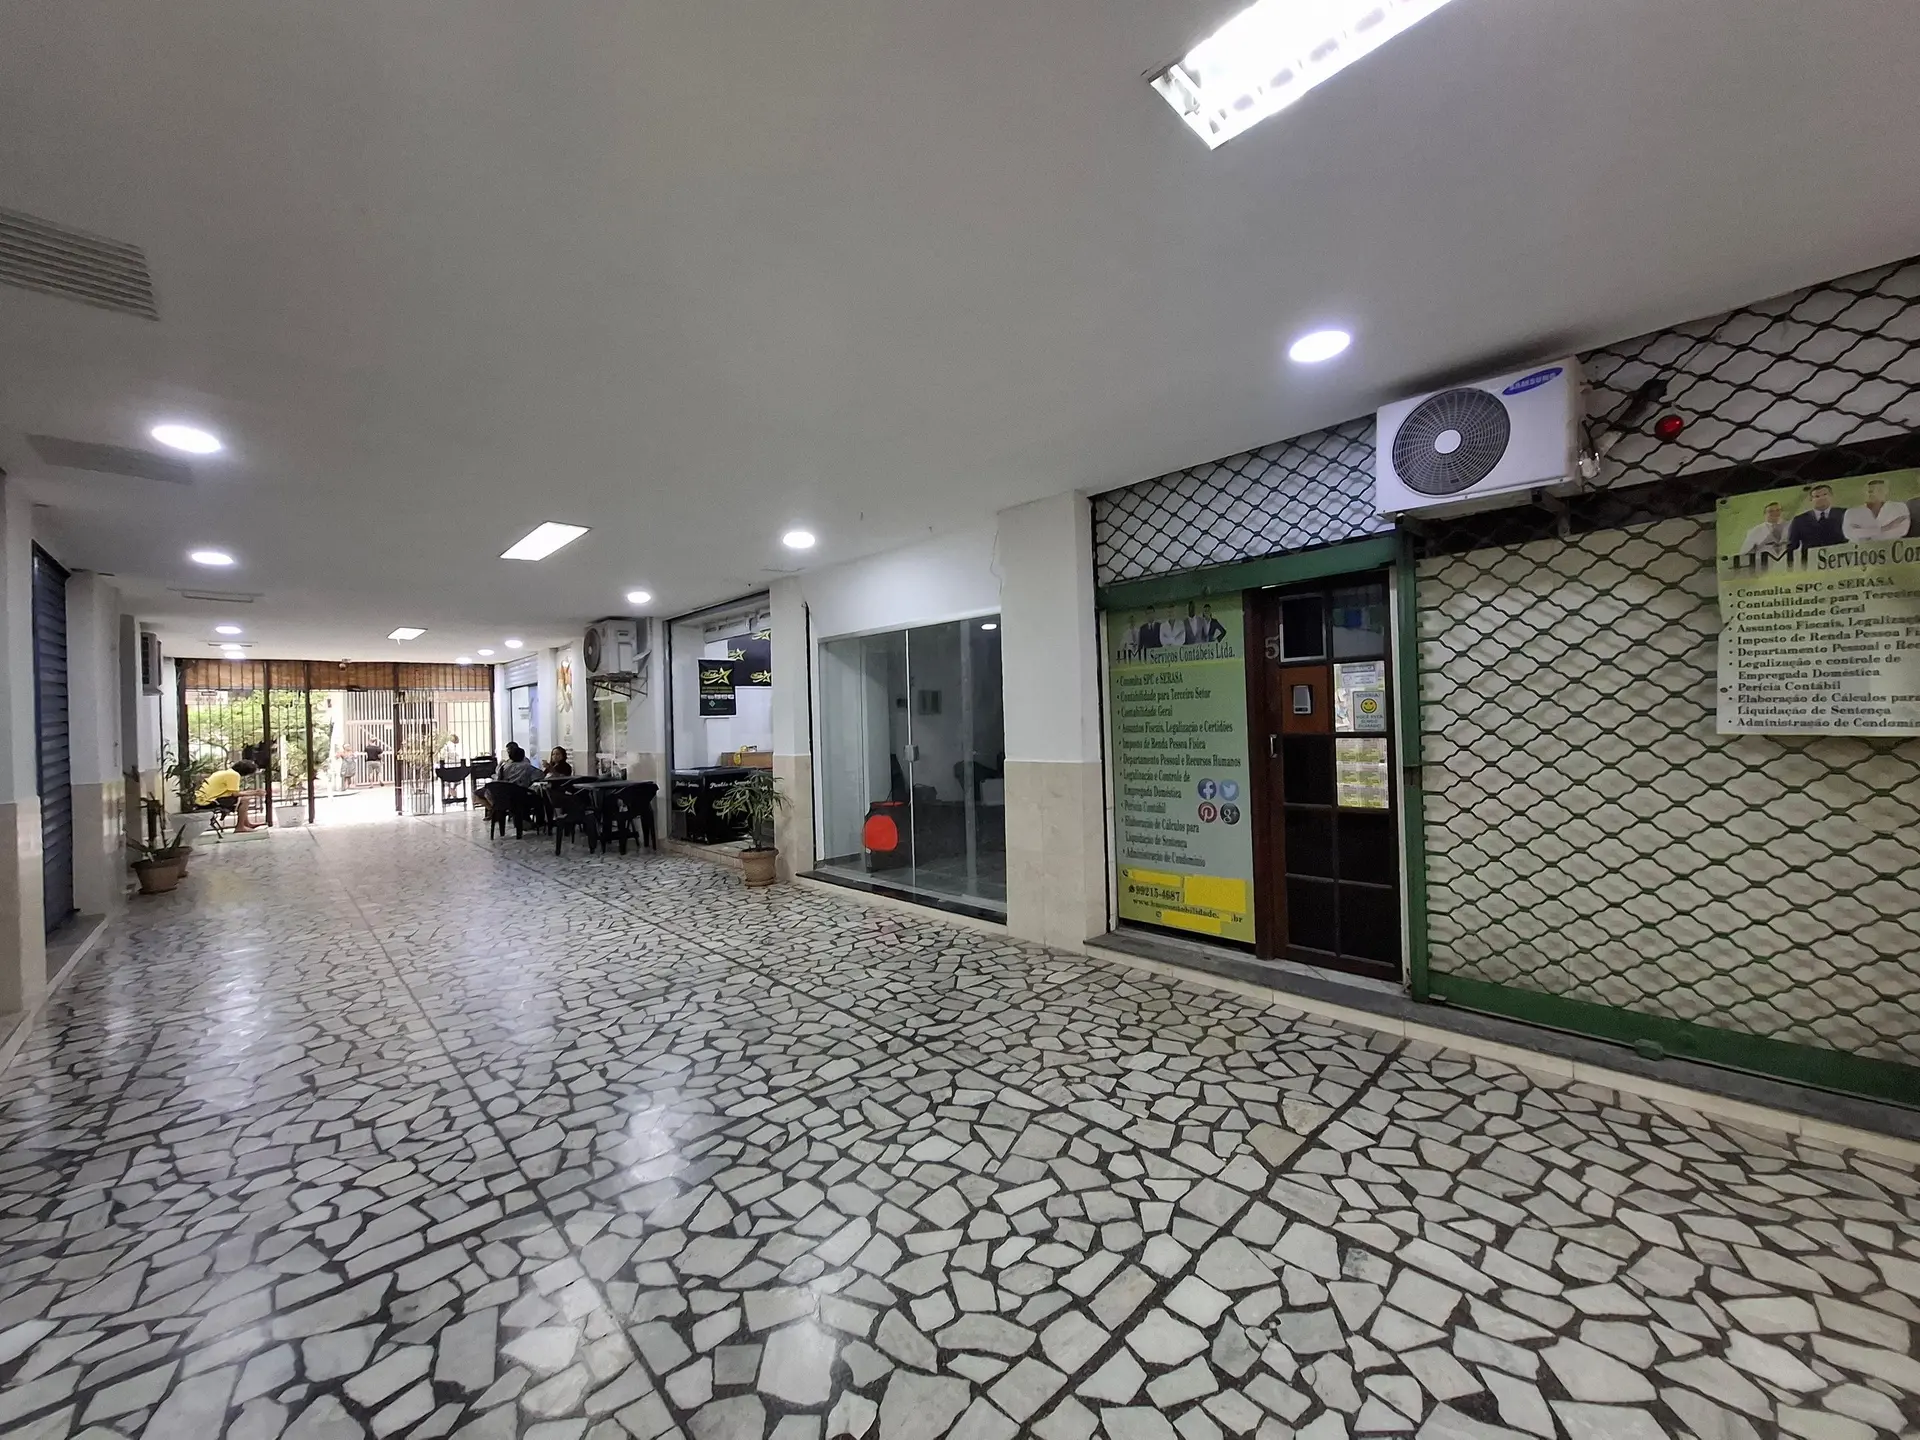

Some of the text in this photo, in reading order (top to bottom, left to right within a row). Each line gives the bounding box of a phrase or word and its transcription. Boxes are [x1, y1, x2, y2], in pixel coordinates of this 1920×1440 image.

[1817, 547, 1886, 571] Serviços
[1737, 586, 1792, 598] Consulta
[1795, 582, 1823, 594] SPC
[1838, 576, 1895, 590] SERASA
[1737, 595, 1828, 610] Contabilidade
[1830, 594, 1859, 606] para
[1737, 604, 1866, 622] Contabilidade Geral
[1737, 623, 1793, 633] Assuntos
[1737, 635, 1787, 646] Imposto
[1790, 633, 1806, 642] de
[1810, 630, 1851, 641] Renda
[1855, 628, 1900, 639] Pessoa
[1150, 649, 1178, 667] Serviços
[1180, 642, 1214, 662] Contábeis
[1216, 642, 1236, 660] Ltda.
[1737, 645, 1828, 658] Departamento
[1832, 642, 1880, 653] Pessoal
[1896, 640, 1920, 650] Rec
[1738, 653, 1902, 669] Legalização e controle de
[1738, 668, 1880, 682] Empregada Doméstica
[1738, 680, 1841, 692] Perícia Contábil
[1738, 694, 1808, 705] Elaboração
[1811, 693, 1828, 703] de
[1831, 691, 1887, 702] Cálculos
[1737, 705, 1892, 717] Liquidação de Sentença
[1737, 717, 1830, 728] Administração
[1834, 717, 1850, 728] de
